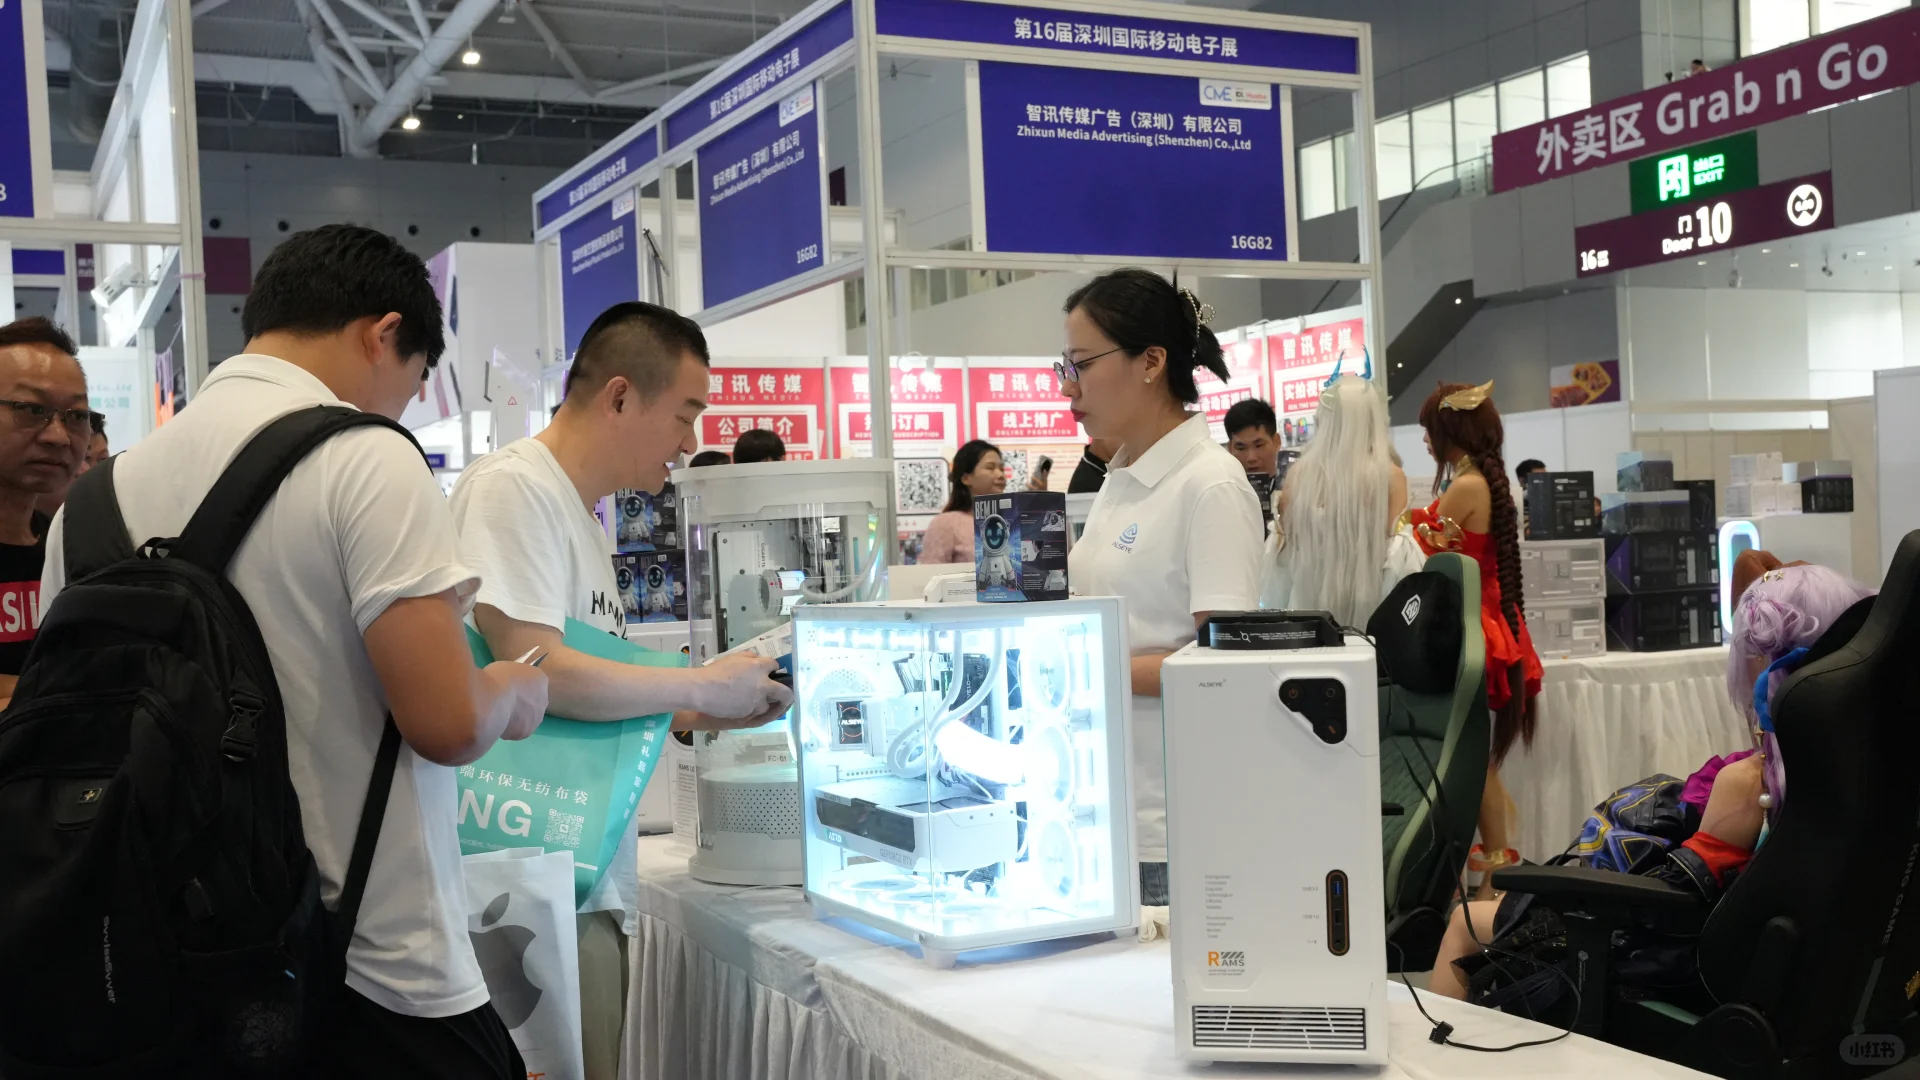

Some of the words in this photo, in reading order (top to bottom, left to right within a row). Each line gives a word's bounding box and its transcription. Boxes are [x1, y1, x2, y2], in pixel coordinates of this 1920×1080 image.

[1013, 17, 1239, 57] 第16届深圳国际移动电子展
[1203, 84, 1233, 102] CME
[1026, 103, 1242, 136] 智讯传媒广告（深圳）有限公司
[1536, 104, 1646, 176] 外卖区
[1656, 72, 1760, 136] Grab
[1776, 68, 1802, 105] n
[1817, 42, 1888, 92] Go
[1016, 125, 1056, 139] Zhixun
[1057, 128, 1090, 141] Media
[1091, 130, 1153, 148] Advertising
[1154, 133, 1213, 150] (Shenzhen)
[1214, 138, 1252, 152] Co.,Ltd
[1693, 153, 1725, 173] 出口
[1694, 169, 1725, 186] EXIT
[1677, 214, 1693, 235] 门
[1695, 201, 1733, 248] 10
[1231, 235, 1274, 251] 16G82
[1662, 237, 1694, 255] Door
[1283, 328, 1354, 361] 智讯传媒
[708, 374, 803, 394] 智讯传媒
[988, 372, 1063, 393] 智讯传
[717, 416, 794, 436] 公司简介
[1002, 411, 1064, 429] 线上推广
[1111, 541, 1133, 554] ALSEYE
[457, 788, 533, 838] NG
[1882, 893, 1904, 945] GAME
